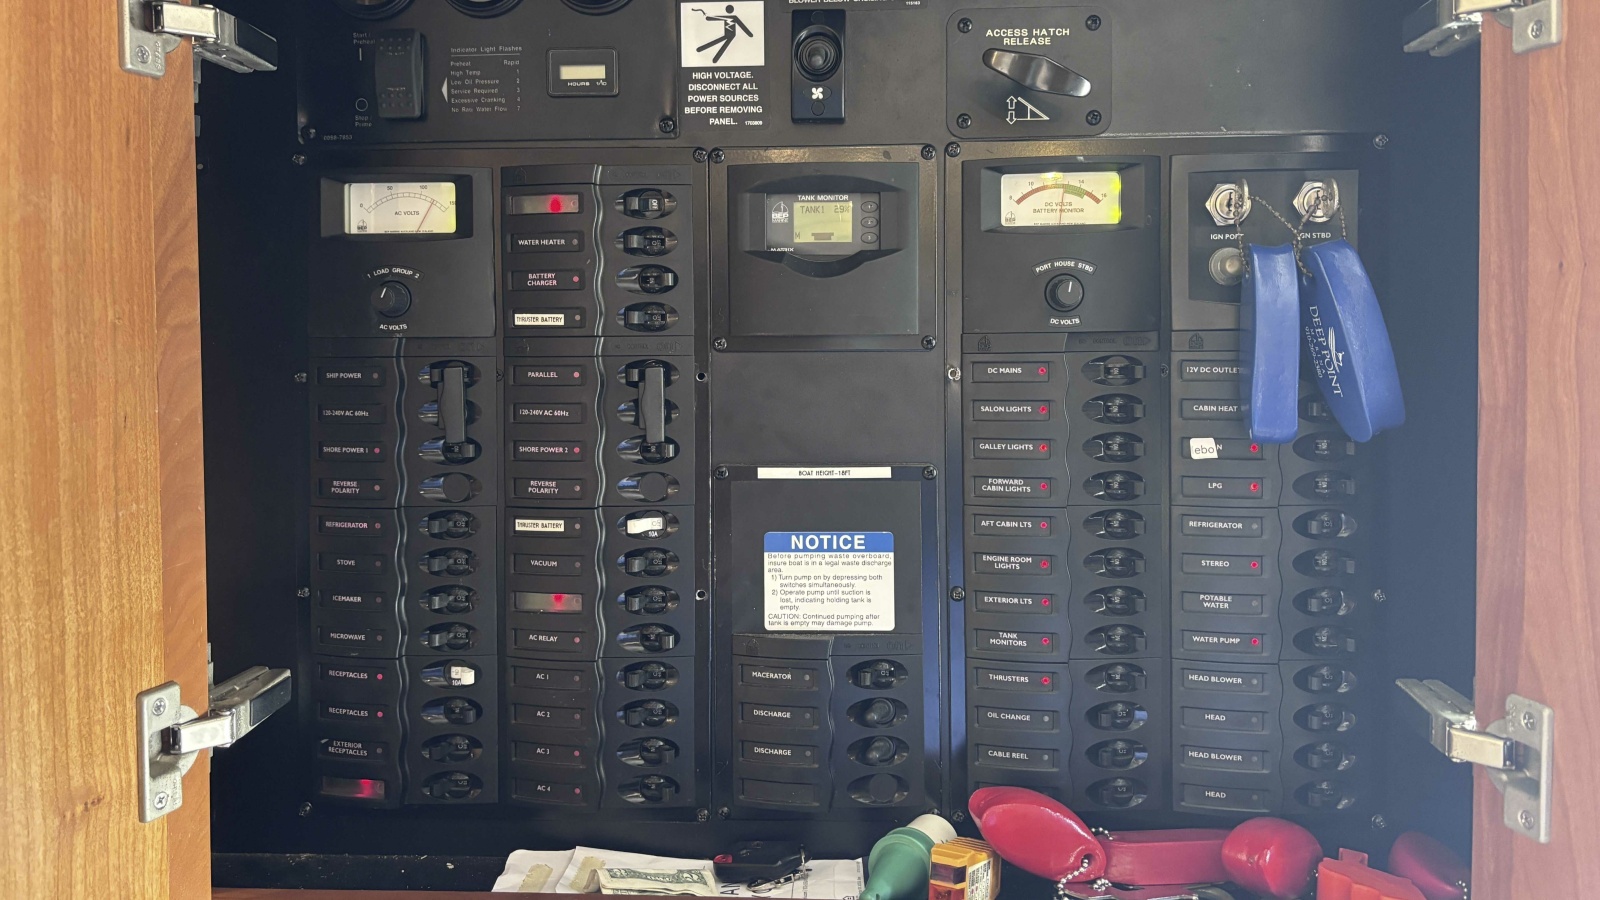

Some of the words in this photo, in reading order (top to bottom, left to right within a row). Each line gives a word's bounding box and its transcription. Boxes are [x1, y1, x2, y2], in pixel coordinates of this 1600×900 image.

[986, 29, 1028, 37] ACCESS
[1033, 28, 1070, 36] HATCH
[1003, 37, 1051, 46] RELEASE
[692, 72, 712, 80] HIGH
[714, 71, 754, 79] VOLTAGE.
[688, 83, 741, 91] DISCONNECT
[687, 95, 718, 103] POWER
[719, 94, 759, 102] SOURCES
[684, 106, 718, 114] BEFORE
[719, 105, 763, 114] REMOVING
[709, 117, 738, 125] PANEL.
[800, 205, 825, 214] TANK1
[1036, 262, 1051, 273] PORT
[1078, 262, 1093, 272] STBD
[1309, 304, 1327, 347] DEEP
[1321, 349, 1344, 398] POINT
[1189, 521, 1243, 529] REFRIGERATOR
[790, 535, 866, 550] NOTICE
[994, 562, 1020, 570] LIGHTS
[1200, 594, 1232, 602] POTABLE
[330, 633, 366, 641] MICROWAVE
[990, 639, 1027, 647] MONITORS
[329, 670, 368, 679] RECEPTACLES
[752, 671, 792, 680] MACERATOR
[989, 674, 1029, 683] THRUSTERS
[1210, 676, 1242, 684] BLOWER
[329, 707, 368, 717] RECEPTACLES
[753, 710, 791, 719] DISCHARGE
[1000, 713, 1030, 721] CHANGE
[333, 741, 362, 749] EXTERIOR
[329, 747, 368, 756] RECEPTACLES
[754, 747, 791, 756] DISCHARGE
[988, 750, 1010, 758] CABLE
[1011, 752, 1029, 760] REEL
[1188, 751, 1209, 759] HEAD
[1210, 753, 1242, 762] BLOWER
[1205, 791, 1226, 799] HEAD
